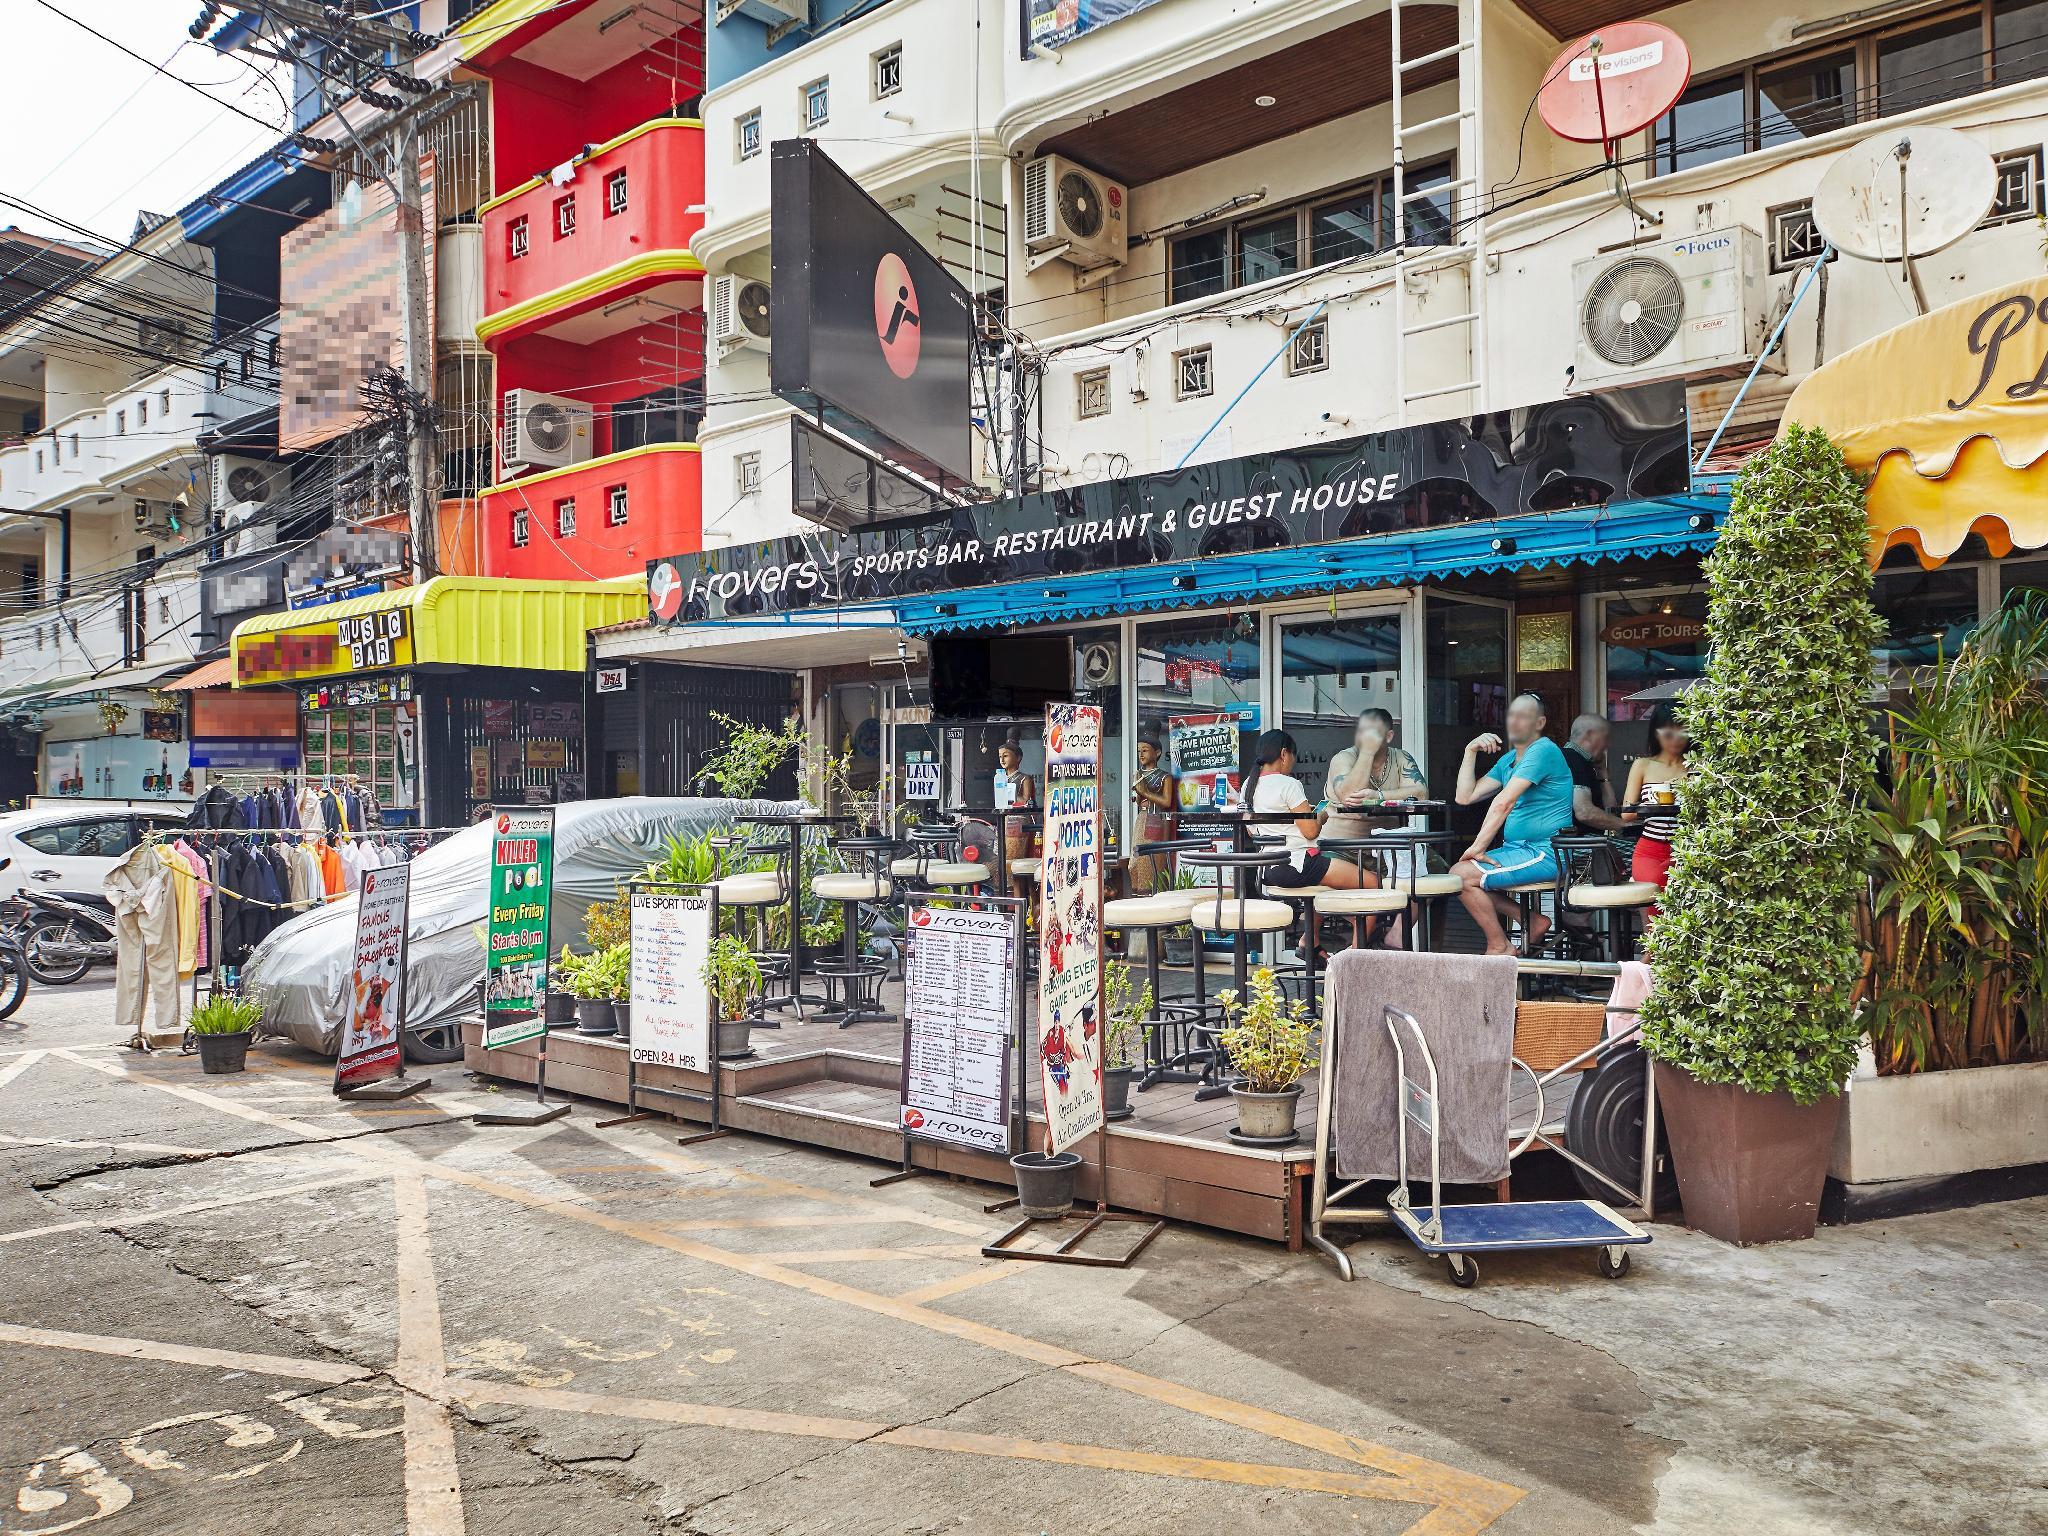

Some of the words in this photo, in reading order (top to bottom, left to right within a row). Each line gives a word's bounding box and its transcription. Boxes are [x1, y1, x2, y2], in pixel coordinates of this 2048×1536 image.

[1034, 13, 1053, 25] THAI
[1614, 50, 1654, 68] visions
[1109, 207, 1121, 221] LG
[1688, 236, 1730, 255] Focus
[852, 547, 928, 577] SPORTS
[935, 539, 985, 566] BAR,
[993, 511, 1155, 557] RESTAURANT
[1161, 509, 1178, 533] &
[1188, 490, 1283, 530] GUEST
[1289, 472, 1400, 515] HOUSE
[339, 612, 399, 645] MUSIC
[1611, 626, 1650, 641] GOLF
[1655, 624, 1701, 638] TOURS
[353, 641, 389, 666] BAR
[604, 672, 621, 686] BSA
[1165, 659, 1221, 681] OPEN
[1199, 734, 1229, 748] MONEY
[1190, 750, 1201, 758] THE
[1200, 743, 1232, 757] MOVIES
[906, 764, 940, 779] LAUN
[908, 781, 935, 796] DRY
[496, 840, 538, 866] KILLER
[633, 896, 651, 910] LIVE
[652, 897, 680, 910] SPORT
[681, 898, 709, 911] TODAY
[493, 906, 518, 925] Every
[519, 902, 545, 921] Friday
[491, 930, 519, 951] Starts
[520, 929, 528, 946] 8
[529, 930, 543, 949] pm
[1043, 968, 1072, 998] PLAYING
[633, 1049, 660, 1064] OPEN
[661, 1051, 675, 1064] 24
[679, 1054, 696, 1068] HRS
[1058, 1102, 1074, 1122] Open
[1074, 1095, 1081, 1110] 24
[1057, 1128, 1067, 1146] Air
